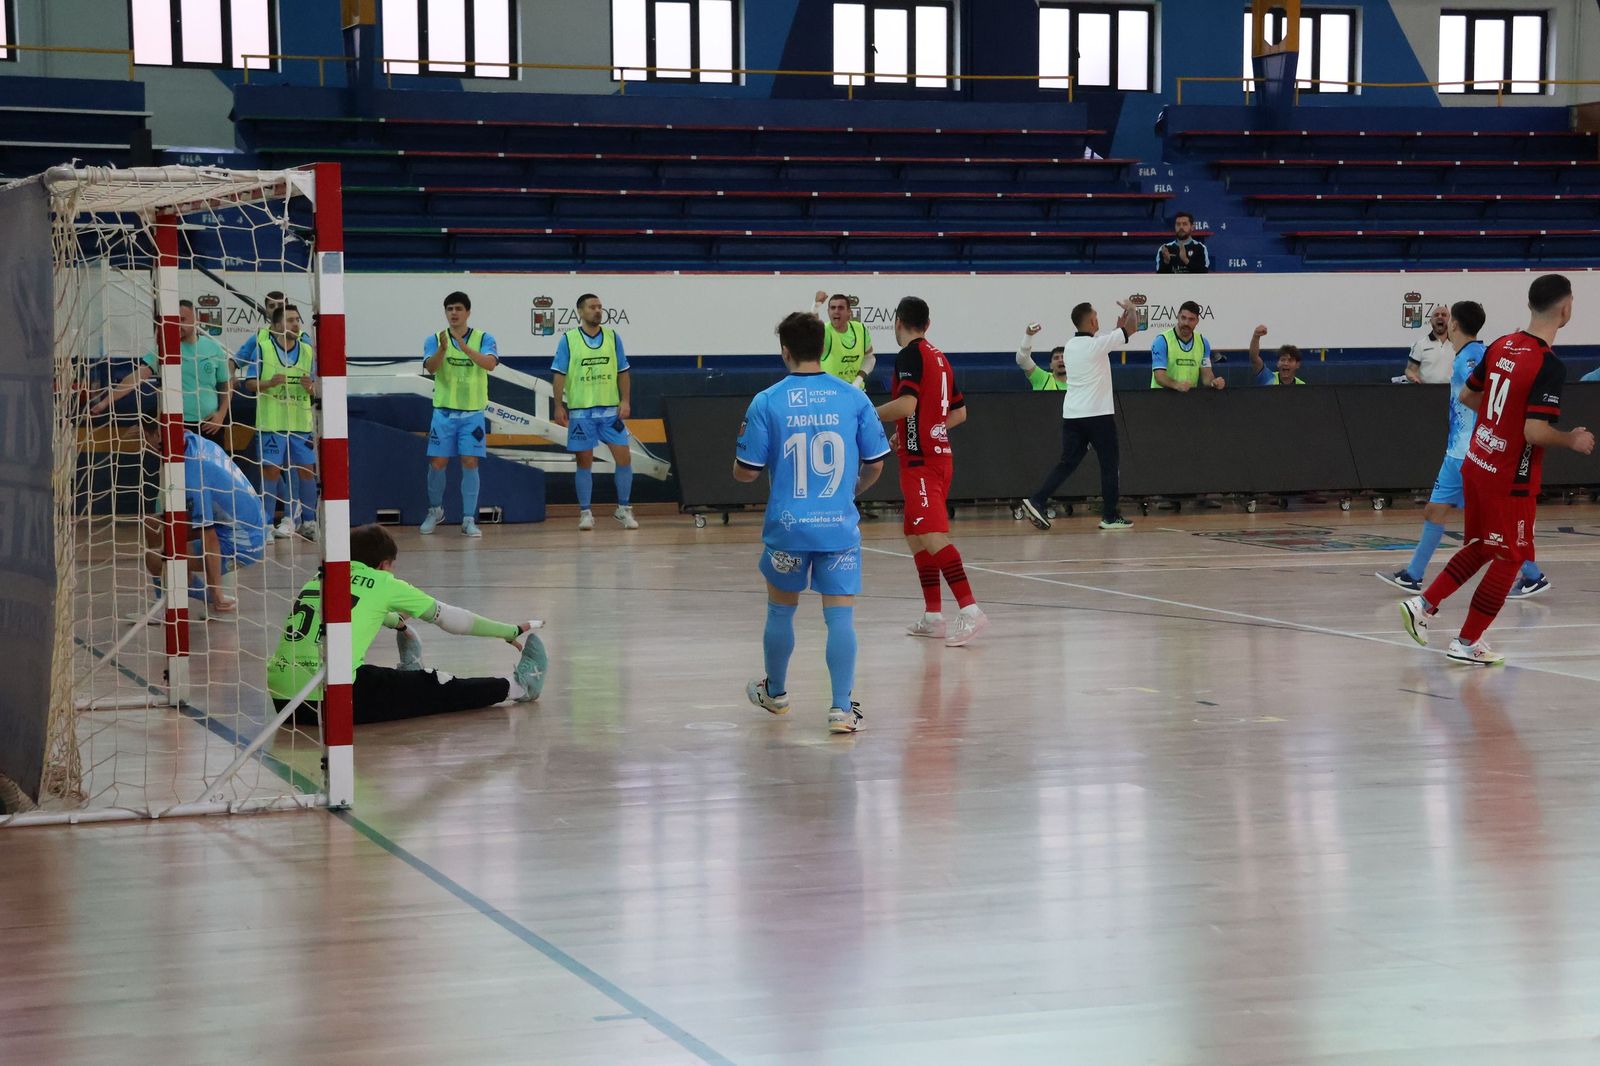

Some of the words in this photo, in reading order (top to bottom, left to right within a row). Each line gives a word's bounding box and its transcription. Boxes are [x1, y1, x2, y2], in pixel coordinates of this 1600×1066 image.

[864, 307, 897, 323] ZAM
[941, 371, 949, 416] 4
[1486, 372, 1511, 426] 14
[496, 408, 530, 426] Sports
[786, 413, 840, 428] ZABALLOS
[783, 430, 846, 499] 19
[351, 574, 375, 589] ETO
